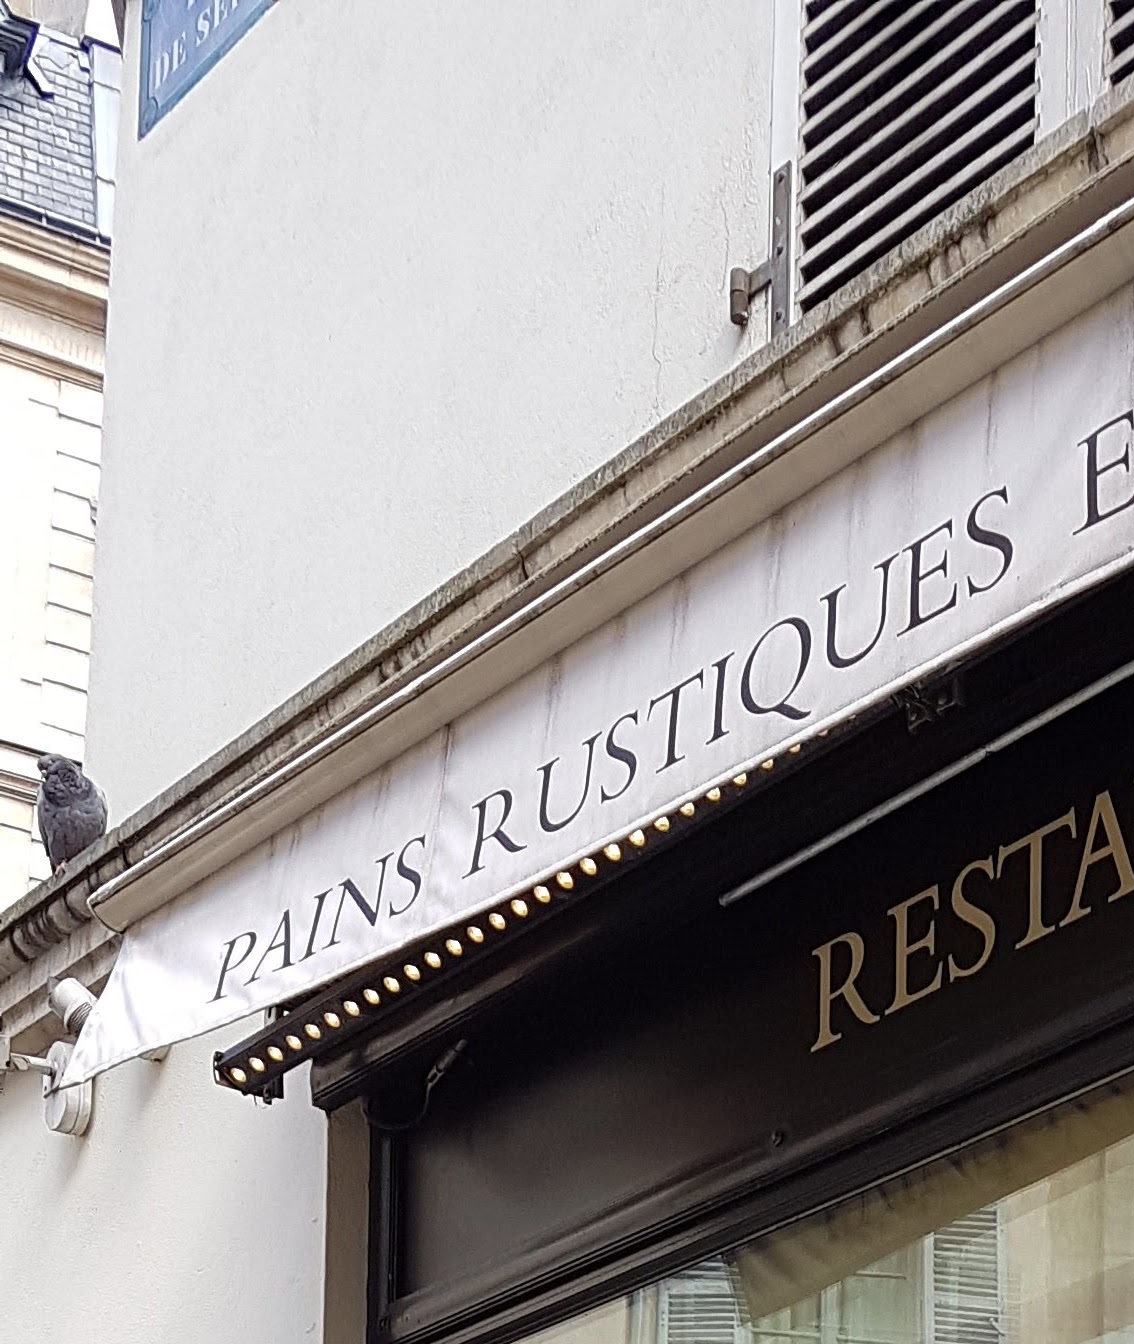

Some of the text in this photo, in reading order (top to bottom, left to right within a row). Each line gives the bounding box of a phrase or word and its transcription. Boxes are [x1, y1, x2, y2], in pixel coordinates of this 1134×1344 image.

[153, 0, 238, 91] DE SE
[211, 834, 428, 1002] PAINS
[461, 485, 1016, 879] RUSTIQUES
